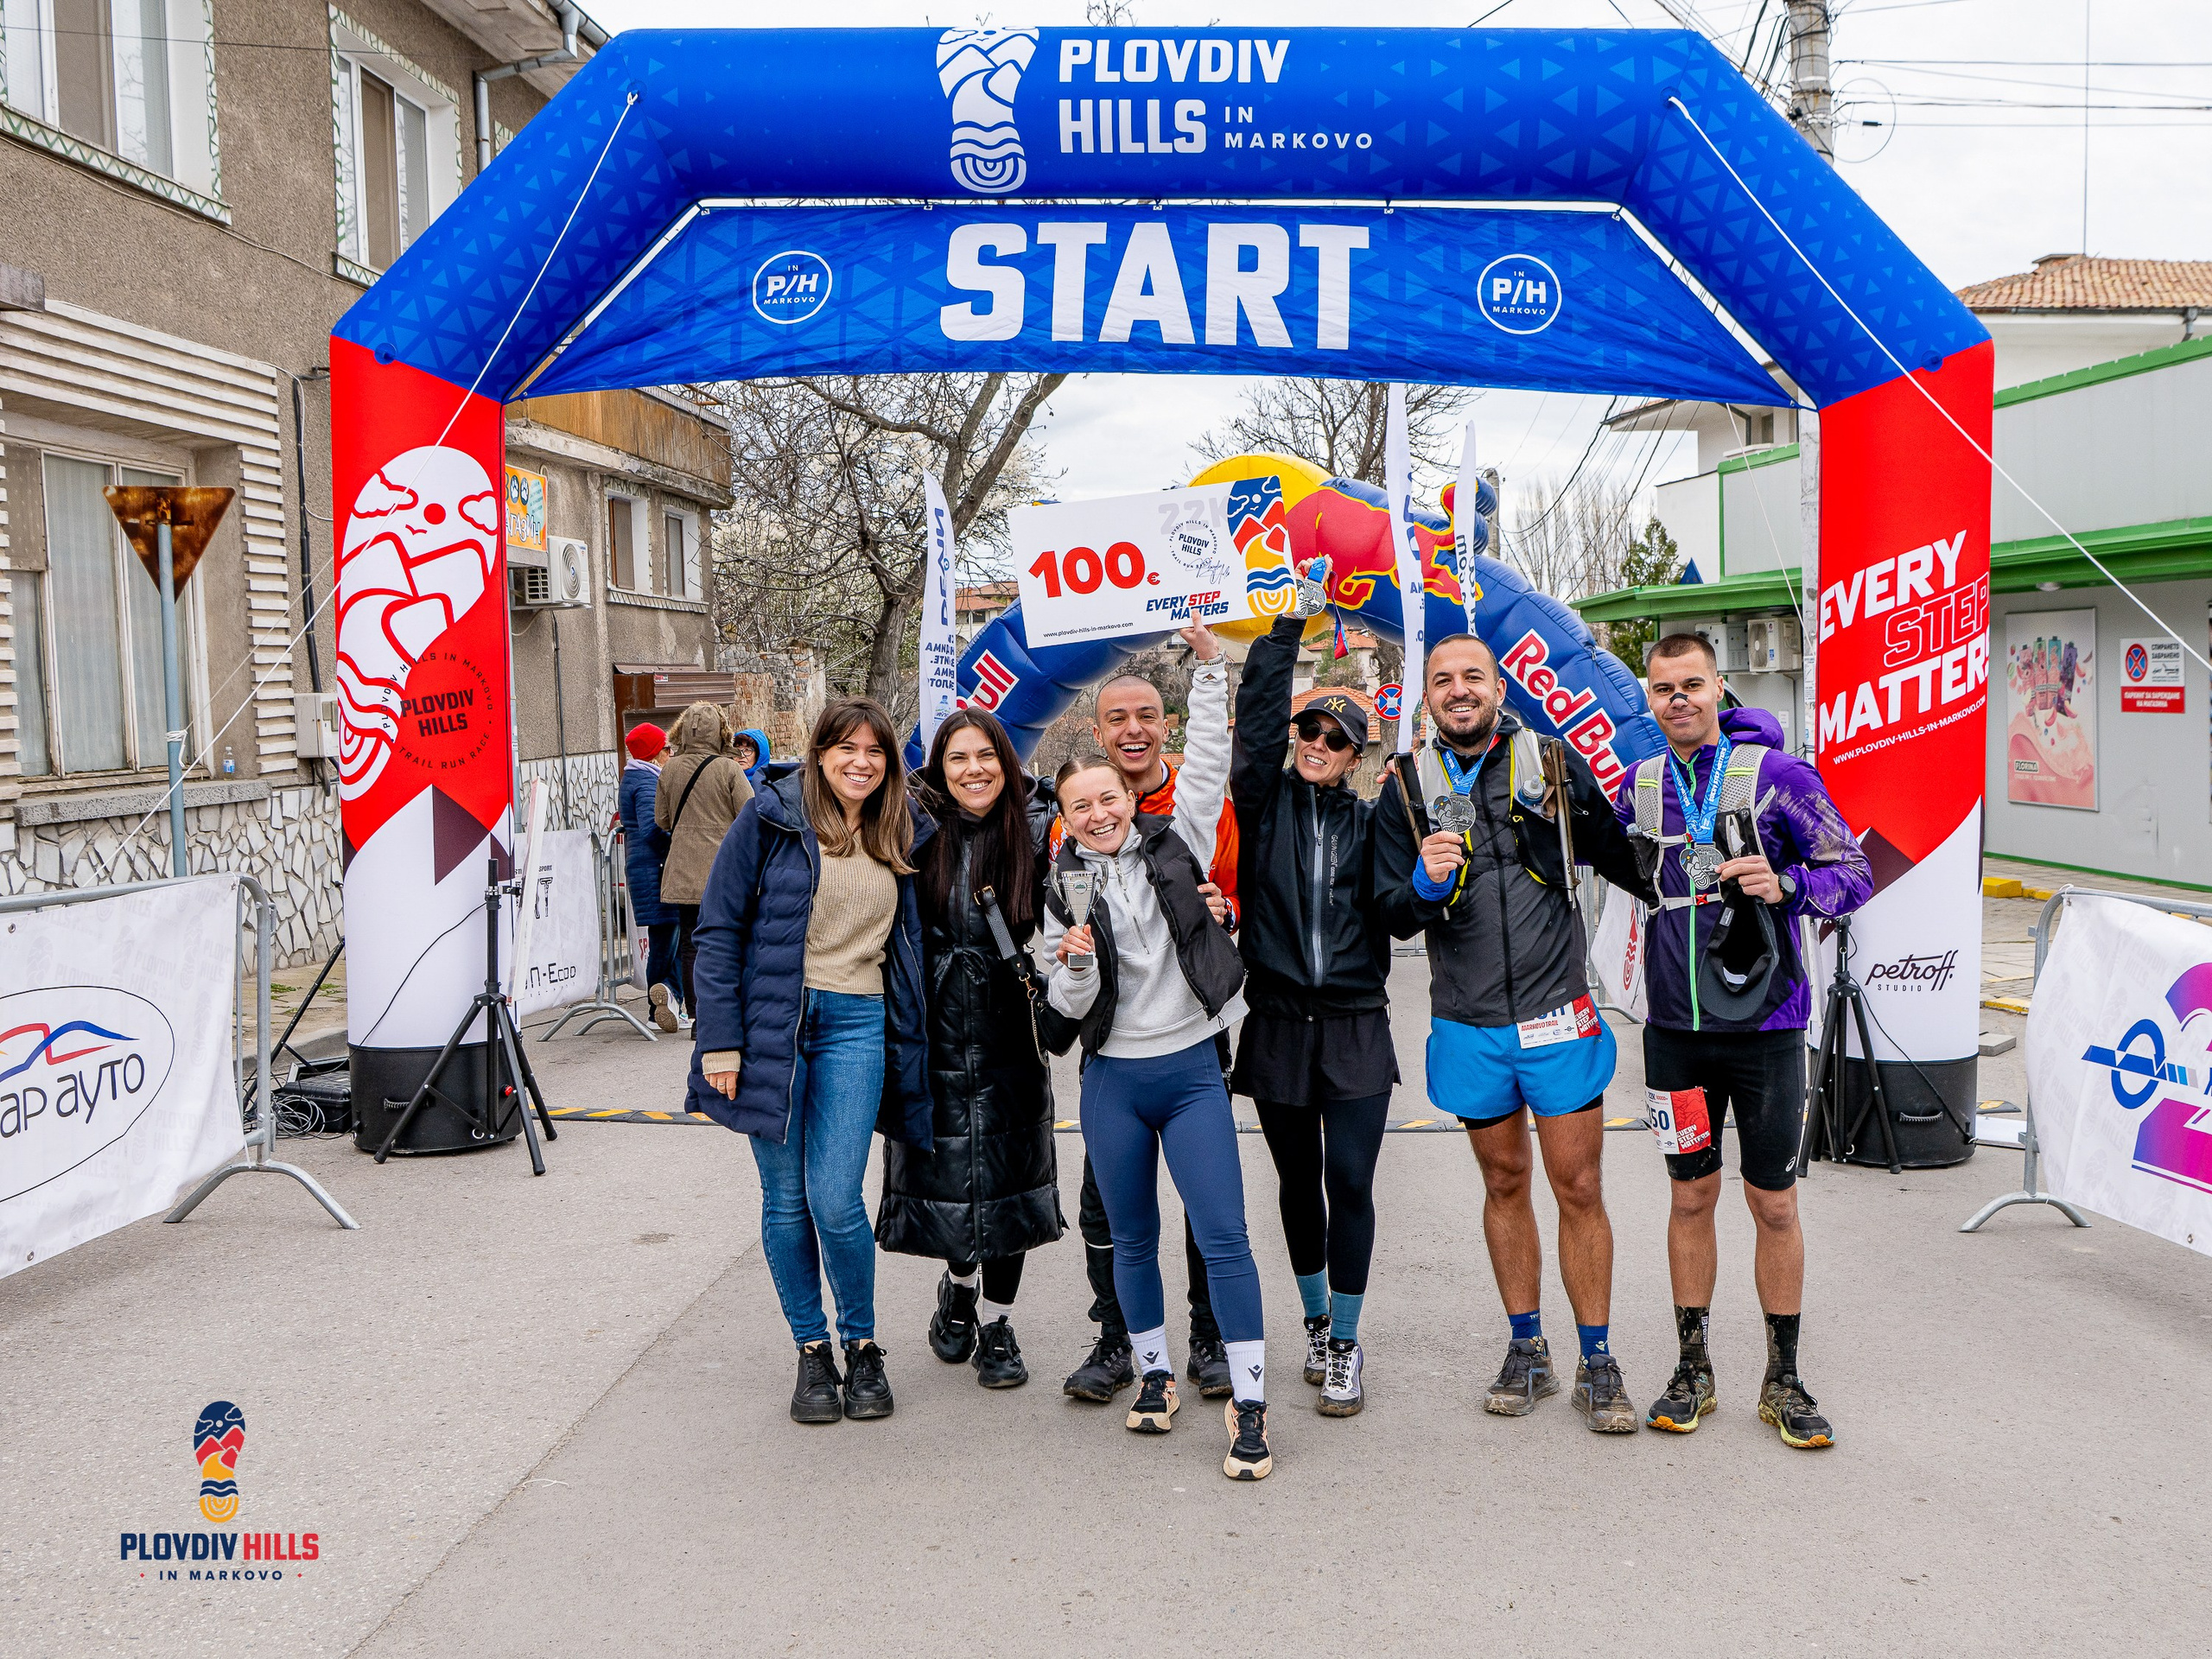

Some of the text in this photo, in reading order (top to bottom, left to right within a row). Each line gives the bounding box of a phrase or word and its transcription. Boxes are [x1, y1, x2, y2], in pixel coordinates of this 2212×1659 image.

[1058, 39, 1291, 84] PLOVDIV
[1059, 99, 1207, 154] HILLS
[1224, 106, 1253, 124] IN
[1224, 132, 1373, 149] MARKOVO
[766, 273, 819, 297] P/H
[939, 221, 1370, 351] START
[1492, 277, 1547, 305] P/H
[763, 296, 816, 305] MARKOVO
[1492, 306, 1546, 315] MARKOVO
[1178, 533, 1210, 549] PLOVDIV
[1181, 543, 1202, 556] HILLS
[1818, 529, 1967, 645] EVERY
[1146, 590, 1221, 612] EVERY STEP
[1043, 621, 1134, 638] www.plovdiv-hills-in-markovo.com
[1883, 570, 1989, 668] STEP
[380, 652, 493, 729] PLOVDIV HILLS IN MARKOVO
[400, 688, 474, 718] PLOVDIV
[417, 712, 468, 737] HILLS
[1500, 630, 1627, 804] Red Bul
[1833, 695, 1986, 766] WWW.PLOVDIV-HILLS-IN-MARKOVO.COM
[397, 732, 490, 769] TRAIL RUN RACE
[1878, 983, 1922, 992] STUDIO
[1676, 1124, 1697, 1138] EVERY
[1678, 1133, 1695, 1144] STEP
